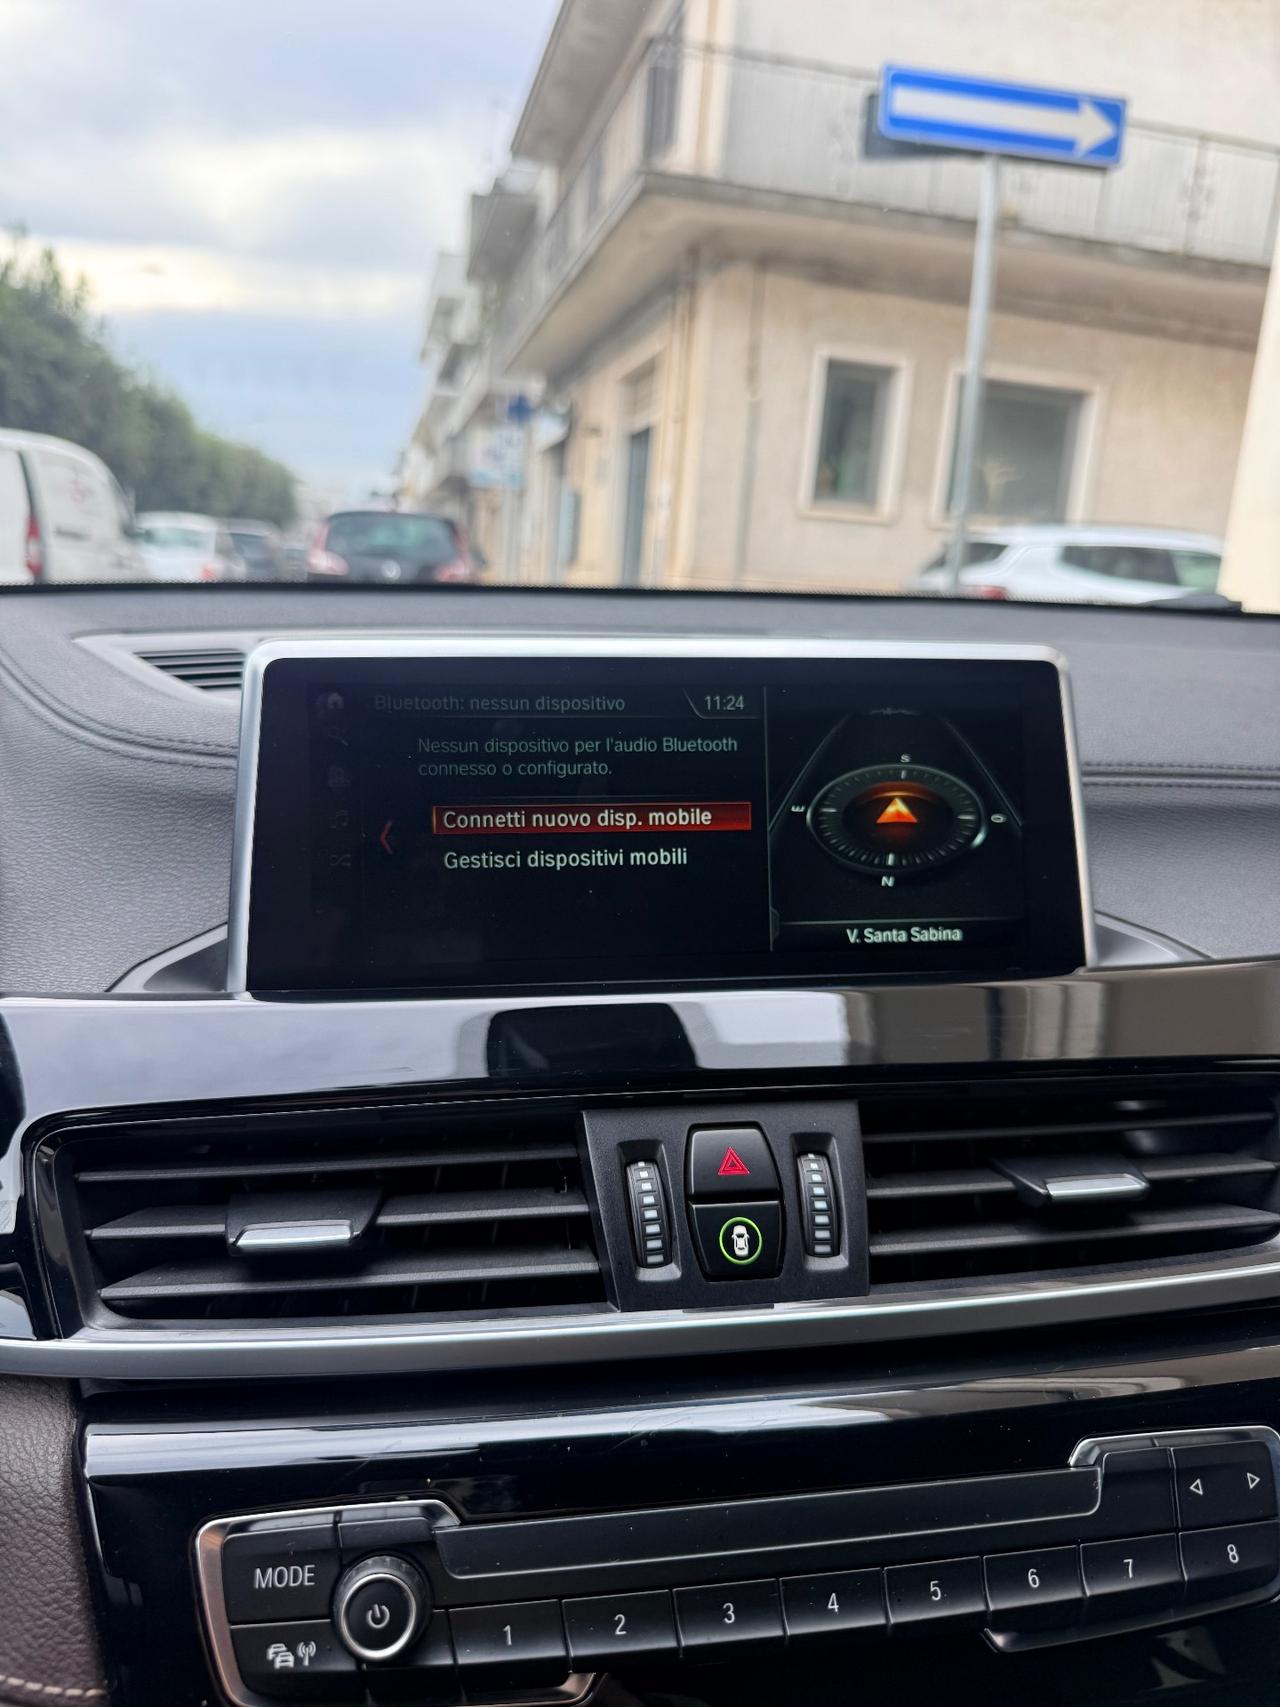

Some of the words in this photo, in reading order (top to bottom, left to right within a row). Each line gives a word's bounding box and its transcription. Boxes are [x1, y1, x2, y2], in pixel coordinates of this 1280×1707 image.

[375, 695, 465, 713] Bluetooth:
[470, 698, 531, 712] nessun
[535, 696, 626, 713] dispositivo
[704, 695, 745, 711] 11:24
[418, 738, 479, 754] Nessun
[484, 737, 570, 757] dispositivo
[575, 741, 601, 756] per
[606, 737, 658, 753] l'audio
[662, 736, 739, 753] Bluetooth
[418, 763, 497, 777] connesso
[502, 763, 513, 777] o
[518, 759, 613, 779] configurato.
[443, 810, 527, 829] Connetti
[532, 812, 592, 828] nuovo
[597, 809, 643, 831] disp.
[648, 807, 713, 826] mobile
[444, 850, 522, 870] Gestisci
[527, 848, 625, 871] dispositivi
[630, 847, 689, 867] mobili
[846, 928, 861, 944] V.
[863, 927, 908, 944] Santa
[910, 926, 963, 943] Sabina
[1226, 1543, 1240, 1565] 8
[253, 1564, 317, 1590] MODE
[1027, 1568, 1041, 1590] 6
[1123, 1557, 1136, 1580] 7
[929, 1579, 943, 1602] 5
[723, 1602, 737, 1625] 3
[827, 1592, 840, 1614] 4
[502, 1624, 513, 1647] 1
[613, 1613, 627, 1637] 2
